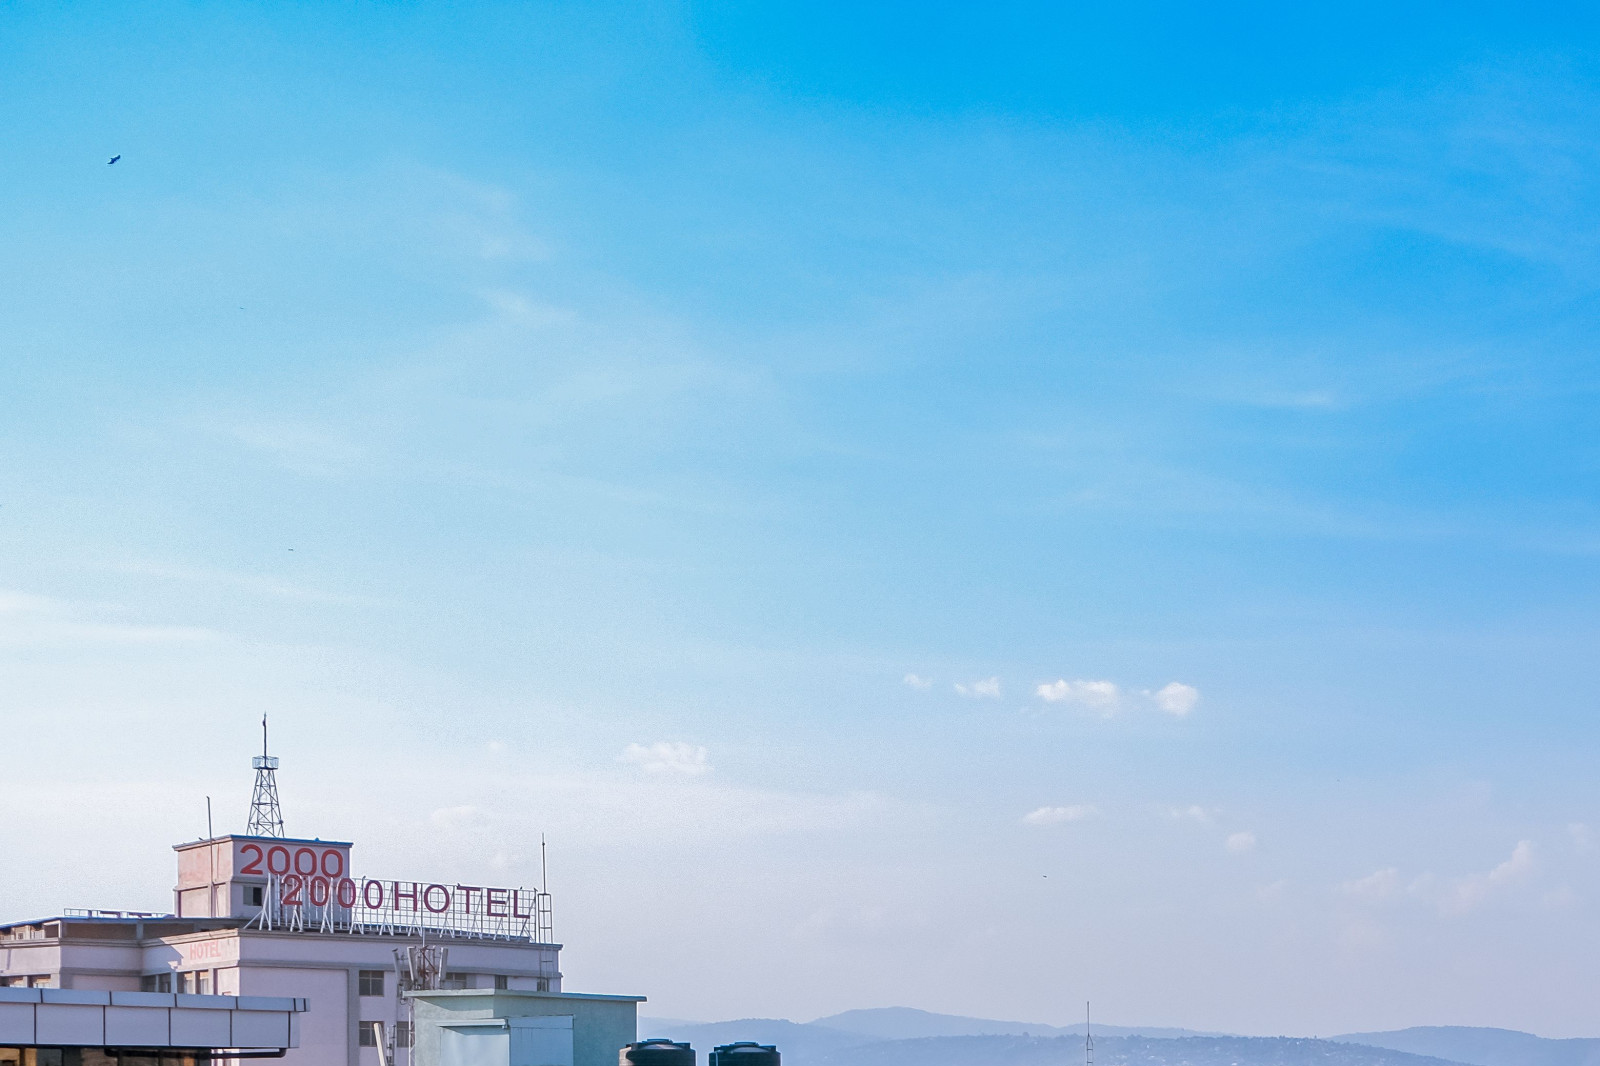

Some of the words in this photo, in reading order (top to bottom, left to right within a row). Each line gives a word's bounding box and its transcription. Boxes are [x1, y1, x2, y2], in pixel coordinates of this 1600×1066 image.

[240, 844, 344, 877] 2000
[281, 874, 384, 909] 2000
[394, 881, 532, 919] HOTEL
[189, 940, 222, 960] HOTEL
